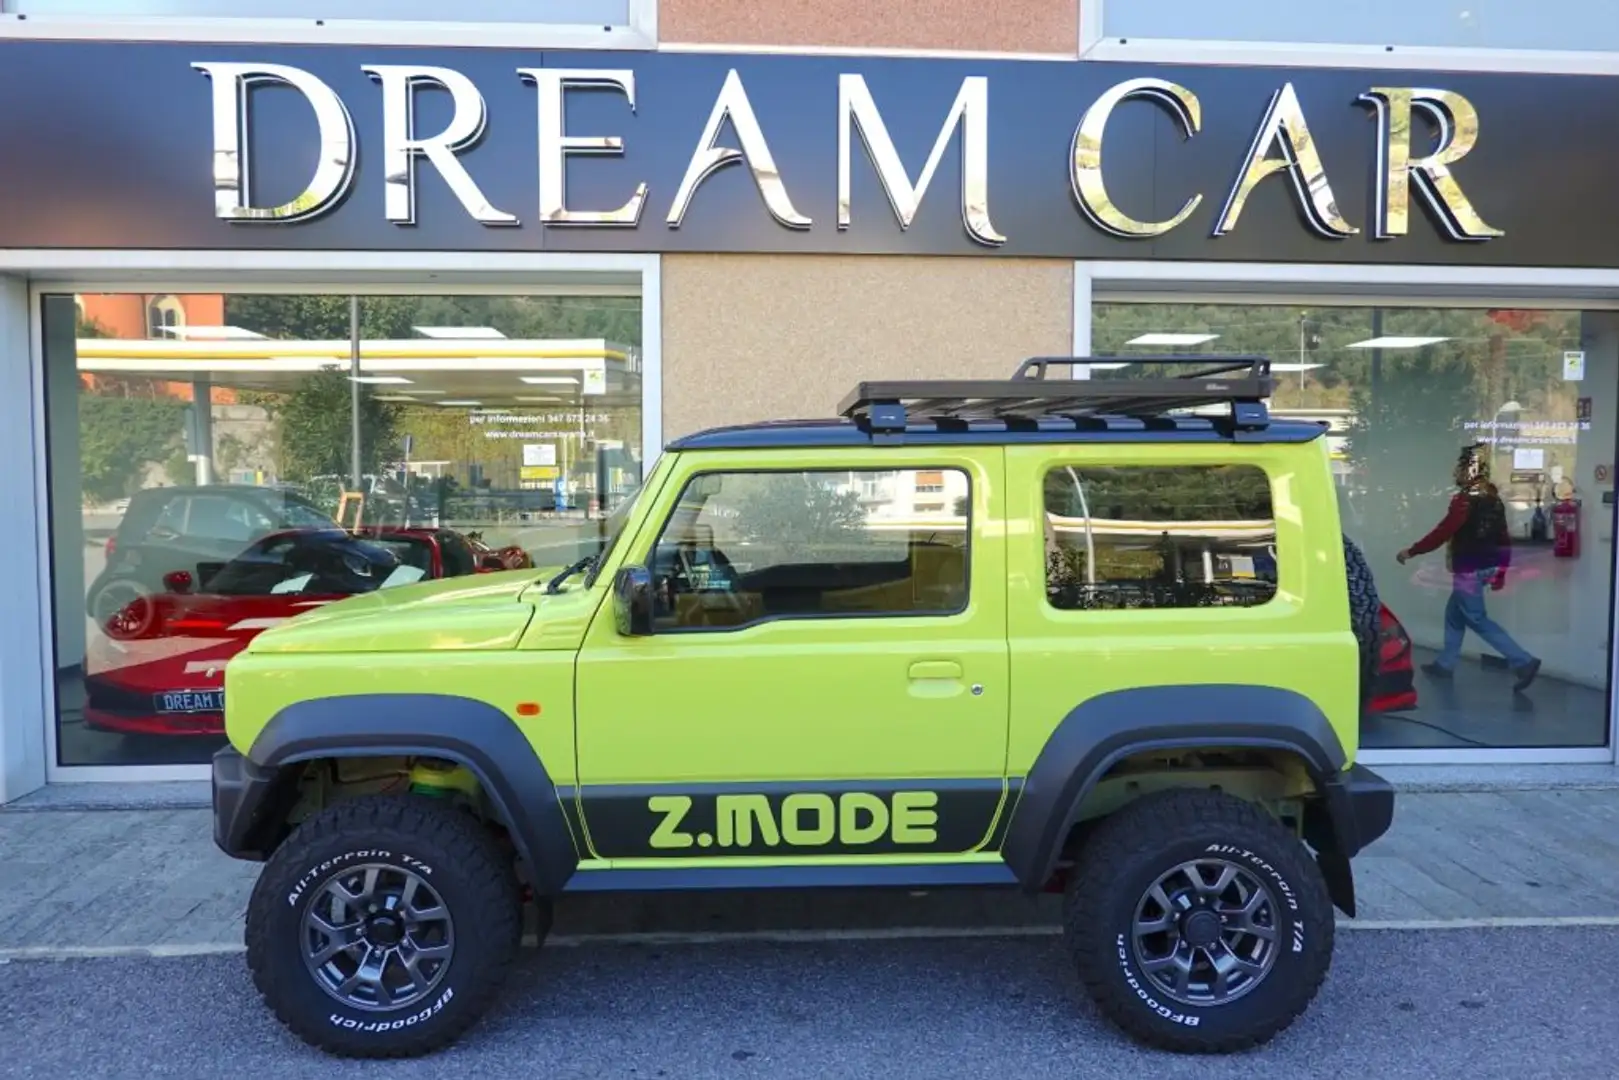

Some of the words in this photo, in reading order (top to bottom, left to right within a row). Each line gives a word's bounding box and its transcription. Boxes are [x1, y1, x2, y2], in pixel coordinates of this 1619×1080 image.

[190, 62, 1006, 246] DREAM
[1069, 77, 1505, 241] CAR
[469, 415, 485, 424] per
[163, 693, 214, 710] DREAM
[648, 791, 938, 848] Z.MODE
[287, 849, 391, 906] All-Terrain
[401, 853, 433, 875] T/A
[1205, 843, 1298, 911] All-Terrain
[1292, 920, 1304, 953] T/A
[1117, 933, 1200, 1026] BFGoodrich
[330, 987, 454, 1032] BFGoodrich
